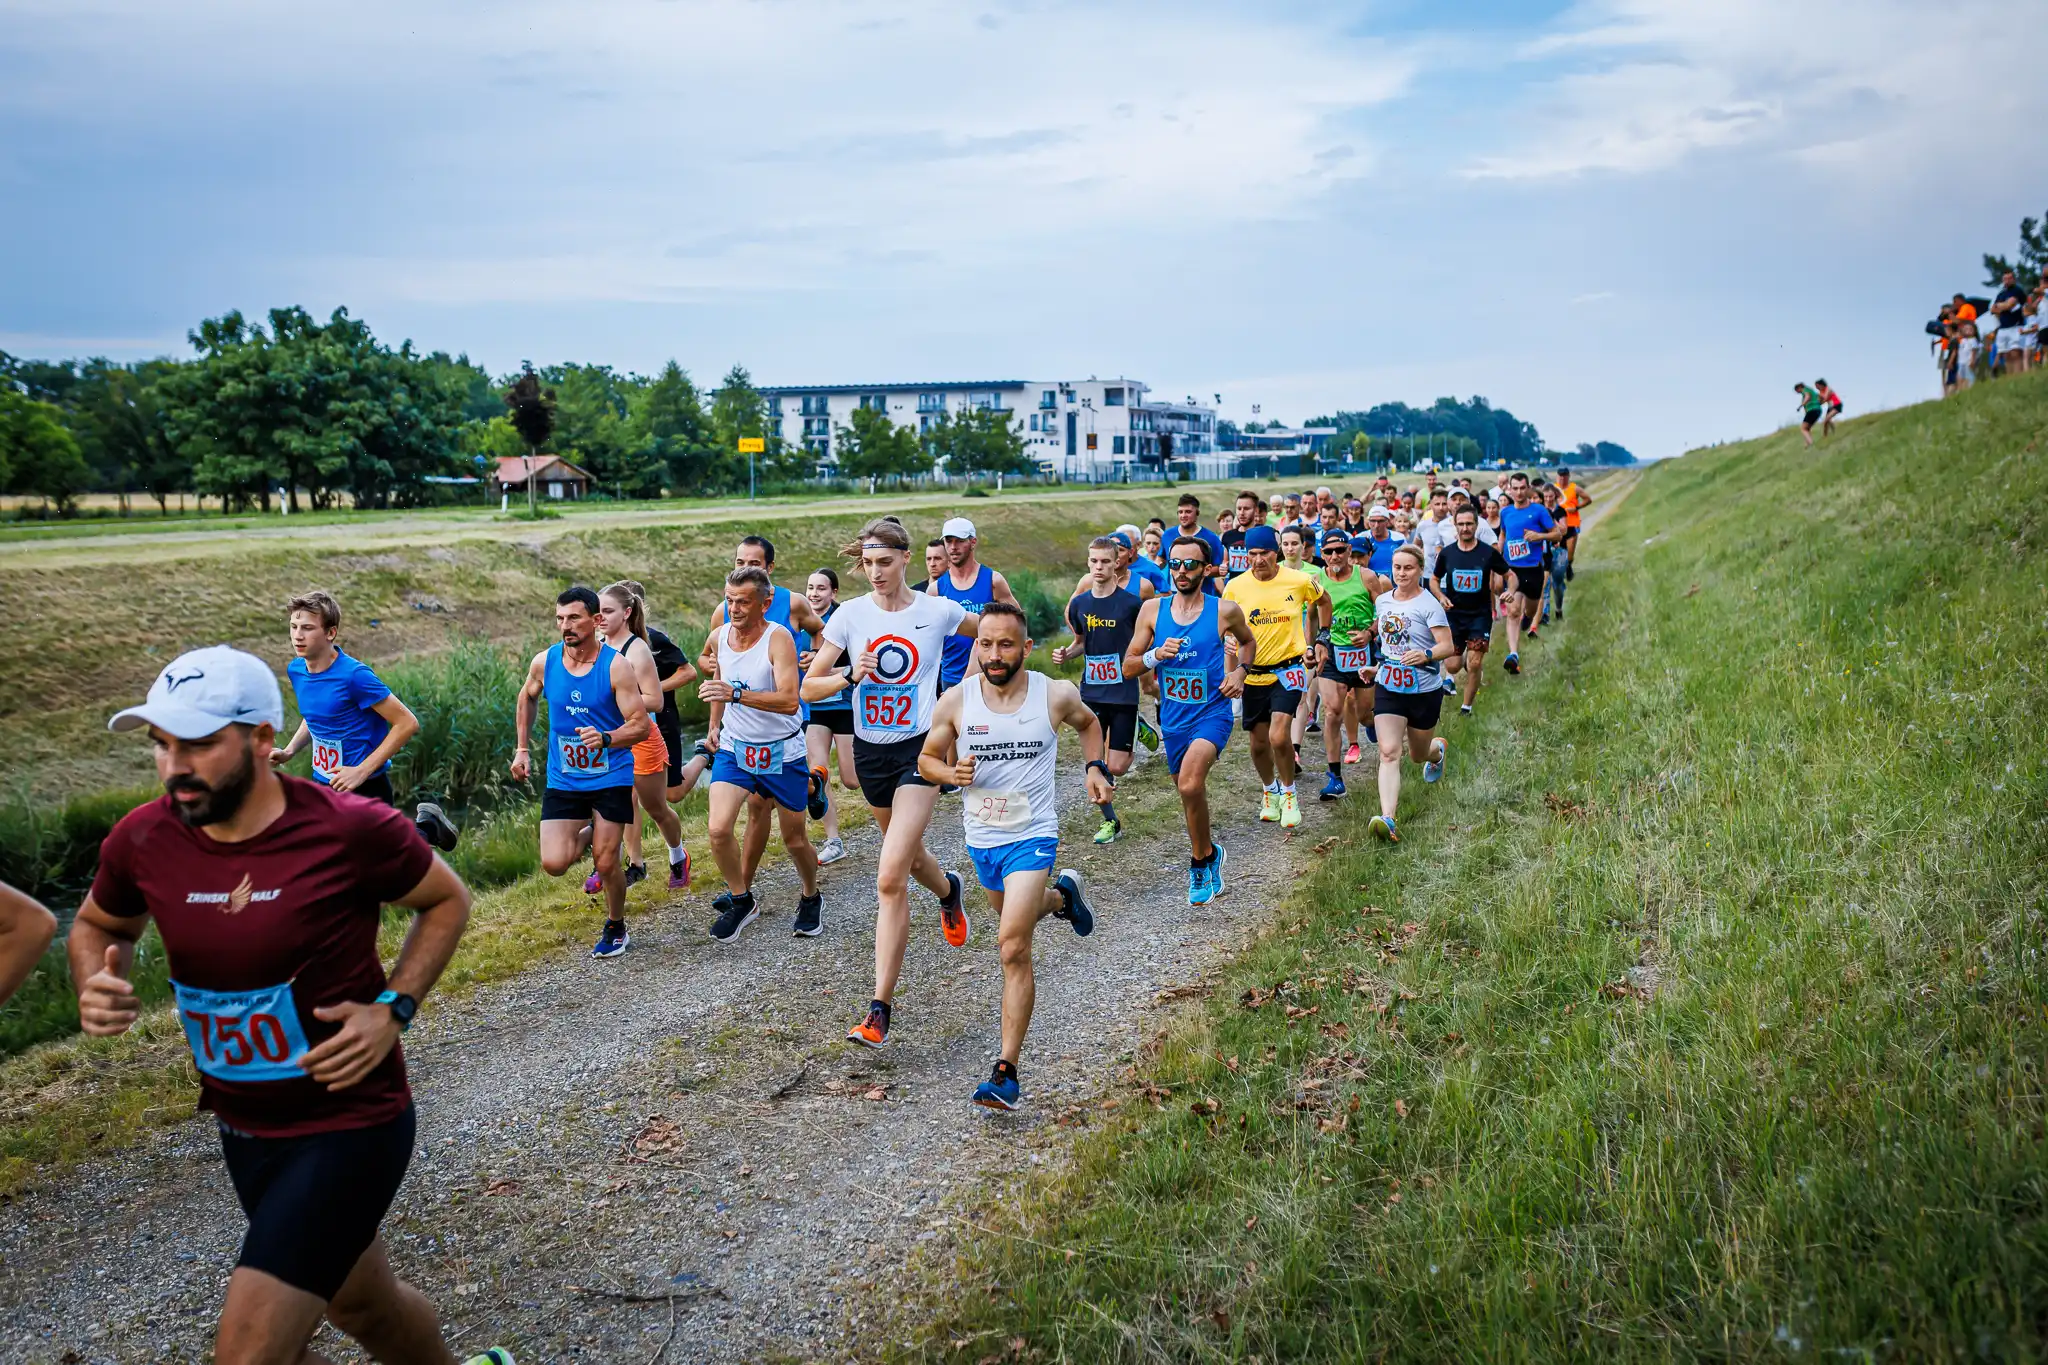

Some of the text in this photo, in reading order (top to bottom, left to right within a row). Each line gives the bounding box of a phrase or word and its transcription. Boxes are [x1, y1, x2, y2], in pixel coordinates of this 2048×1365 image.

[1232, 556, 1249, 568] 773
[1456, 575, 1478, 589] 741
[1339, 651, 1367, 668] 729
[1088, 662, 1118, 680] 705
[1384, 666, 1414, 687] 795
[1165, 676, 1203, 700] 236
[865, 695, 912, 725] 552
[969, 740, 1044, 751] ATLETSKI KLUB
[563, 744, 604, 769] 382
[745, 745, 772, 769] 89
[975, 750, 1038, 761] VARAŽDIN
[976, 797, 1008, 821] 87
[250, 889, 282, 902] HALF
[184, 1010, 290, 1066] 750
